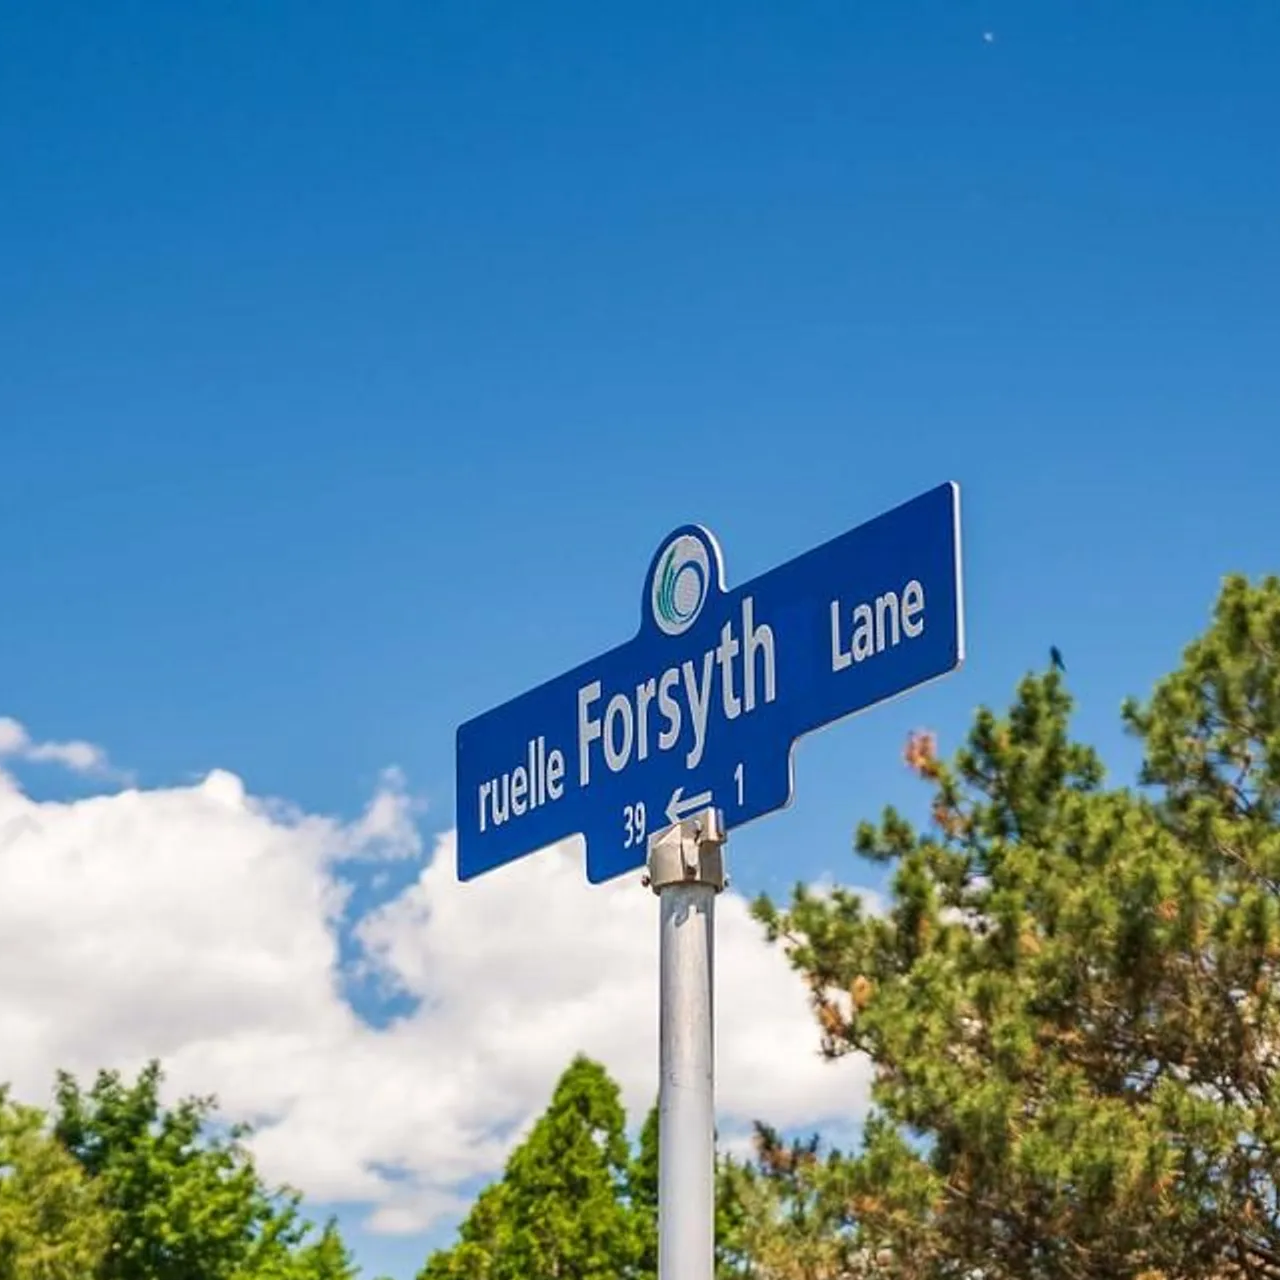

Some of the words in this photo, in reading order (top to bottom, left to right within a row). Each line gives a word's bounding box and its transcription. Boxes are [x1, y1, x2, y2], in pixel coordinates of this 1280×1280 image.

[478, 736, 565, 833] ruelle
[578, 596, 776, 786] Forsyth
[831, 579, 925, 672] Lane
[623, 801, 646, 849] 39
[734, 763, 745, 806] 1
